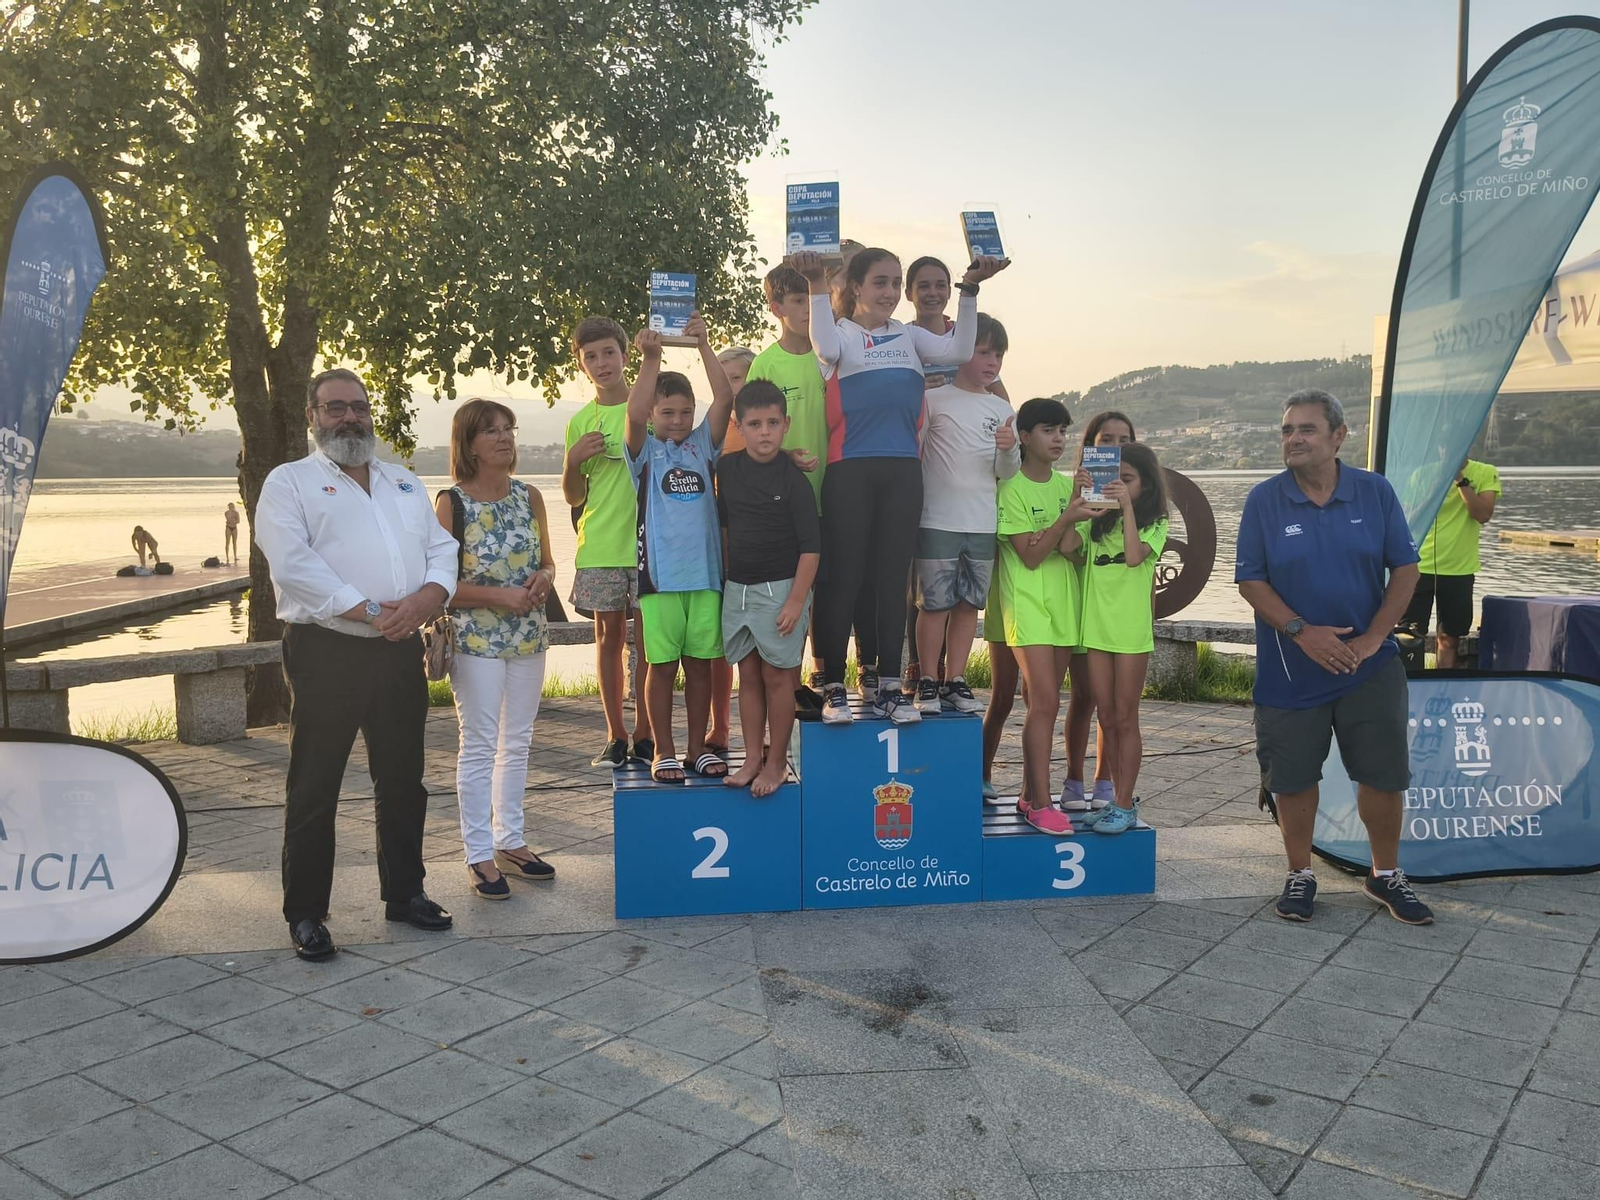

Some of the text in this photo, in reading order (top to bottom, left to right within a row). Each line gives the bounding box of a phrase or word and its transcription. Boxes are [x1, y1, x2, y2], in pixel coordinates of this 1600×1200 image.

[1476, 168, 1552, 186] CONCELLO DE
[788, 185, 808, 194] COPA
[788, 190, 832, 200] DEPUTACIÓN
[1440, 175, 1588, 205] CASTRELO DE MIÑO
[652, 272, 669, 280] COPA
[652, 279, 690, 288] DEPUTACIÓN
[864, 350, 909, 359] RODEIRA
[877, 728, 899, 774] 1
[1404, 778, 1563, 809] EPUTACIÓN
[1410, 815, 1543, 840] OURENSE
[691, 826, 730, 879] 2
[847, 855, 939, 872] Concello de
[1052, 842, 1086, 890] 3
[815, 870, 970, 893] Castrelo de Miño
